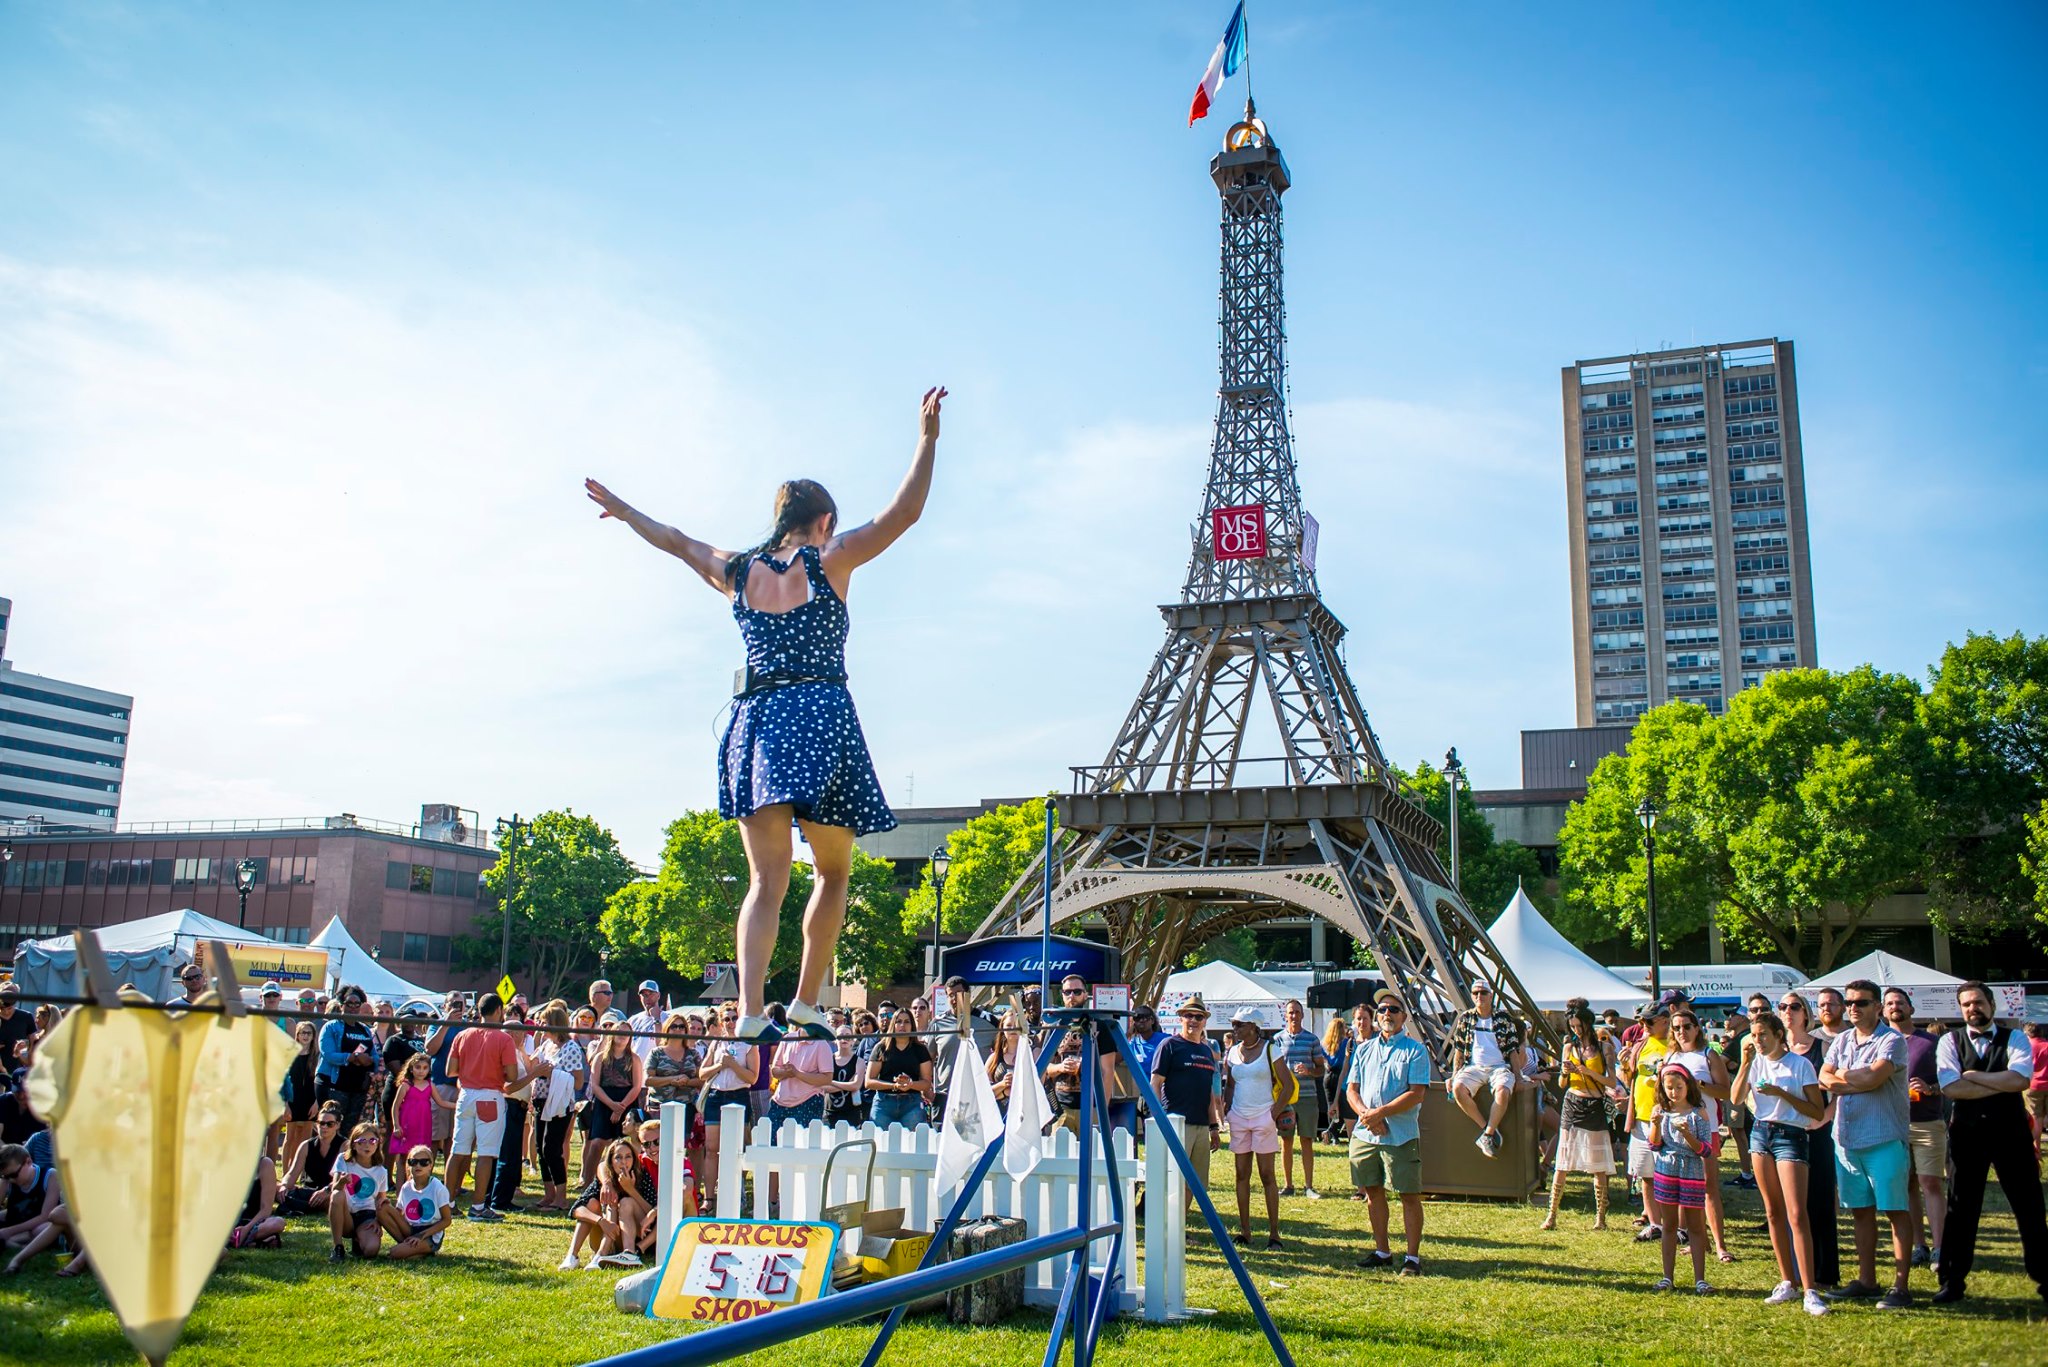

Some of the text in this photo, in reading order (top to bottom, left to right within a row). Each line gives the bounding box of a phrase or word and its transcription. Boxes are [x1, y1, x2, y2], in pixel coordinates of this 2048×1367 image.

[250, 960, 312, 973] MILWAUKEE
[975, 960, 1015, 972] BUD
[697, 1223, 813, 1249] CIRCUS
